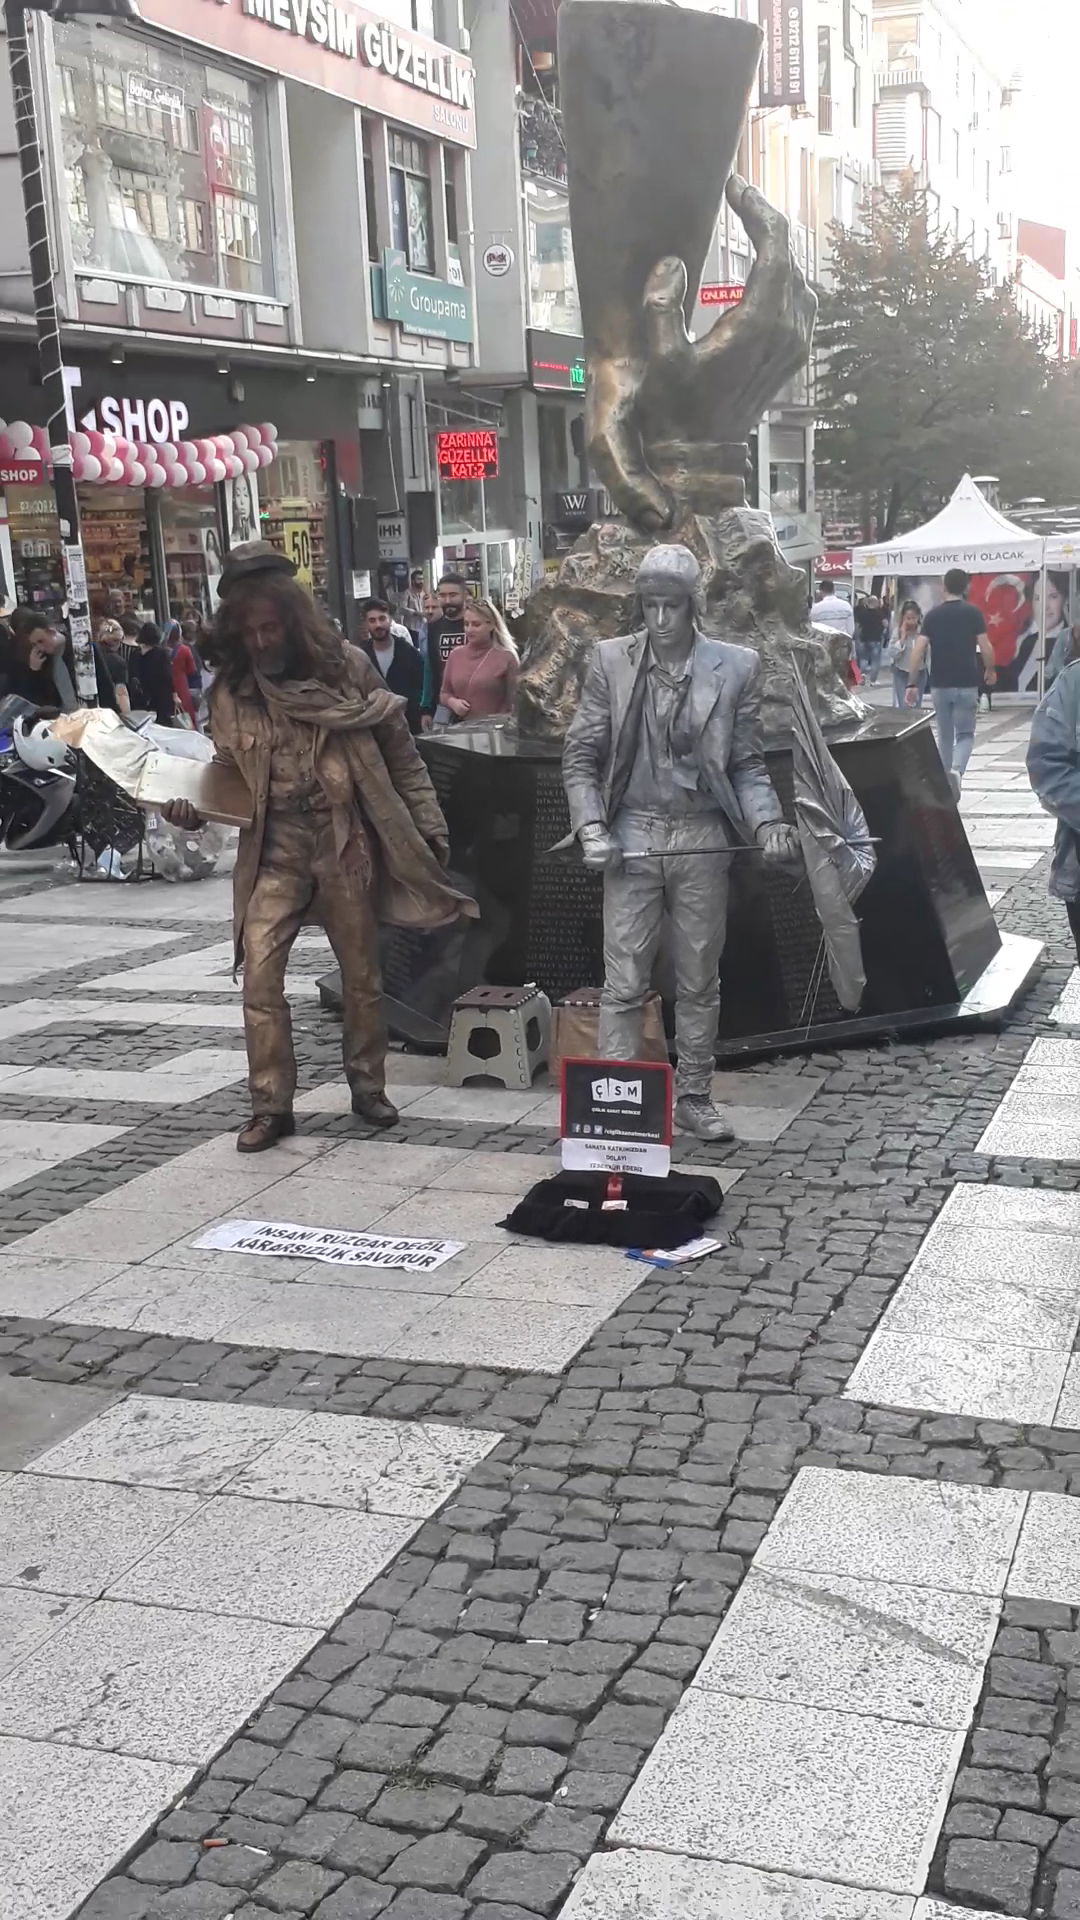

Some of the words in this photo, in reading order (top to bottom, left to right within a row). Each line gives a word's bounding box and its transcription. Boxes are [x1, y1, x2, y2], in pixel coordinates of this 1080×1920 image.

[789, 20, 800, 46] 0212
[362, 20, 473, 108] GÜZELLİK
[432, 104, 469, 133] SALONU
[410, 286, 466, 320] Groupama
[703, 290, 729, 300] ONUR
[100, 396, 189, 443] SHOP
[439, 447, 496, 463] GÜZELLİK
[0, 469, 38, 481] SHOP
[452, 463, 485, 476] KAT:2
[291, 530, 310, 568] 50
[915, 554, 959, 564] TÜRKİYE
[980, 551, 1024, 561] OLACAK
[442, 636, 462, 645] NYC
[584, 1143, 607, 1151] SANATA
[316, 1233, 393, 1249] RÜZGAR
[230, 1238, 352, 1260] KARARSIZLIK
[349, 1251, 438, 1267] SAVURUR
